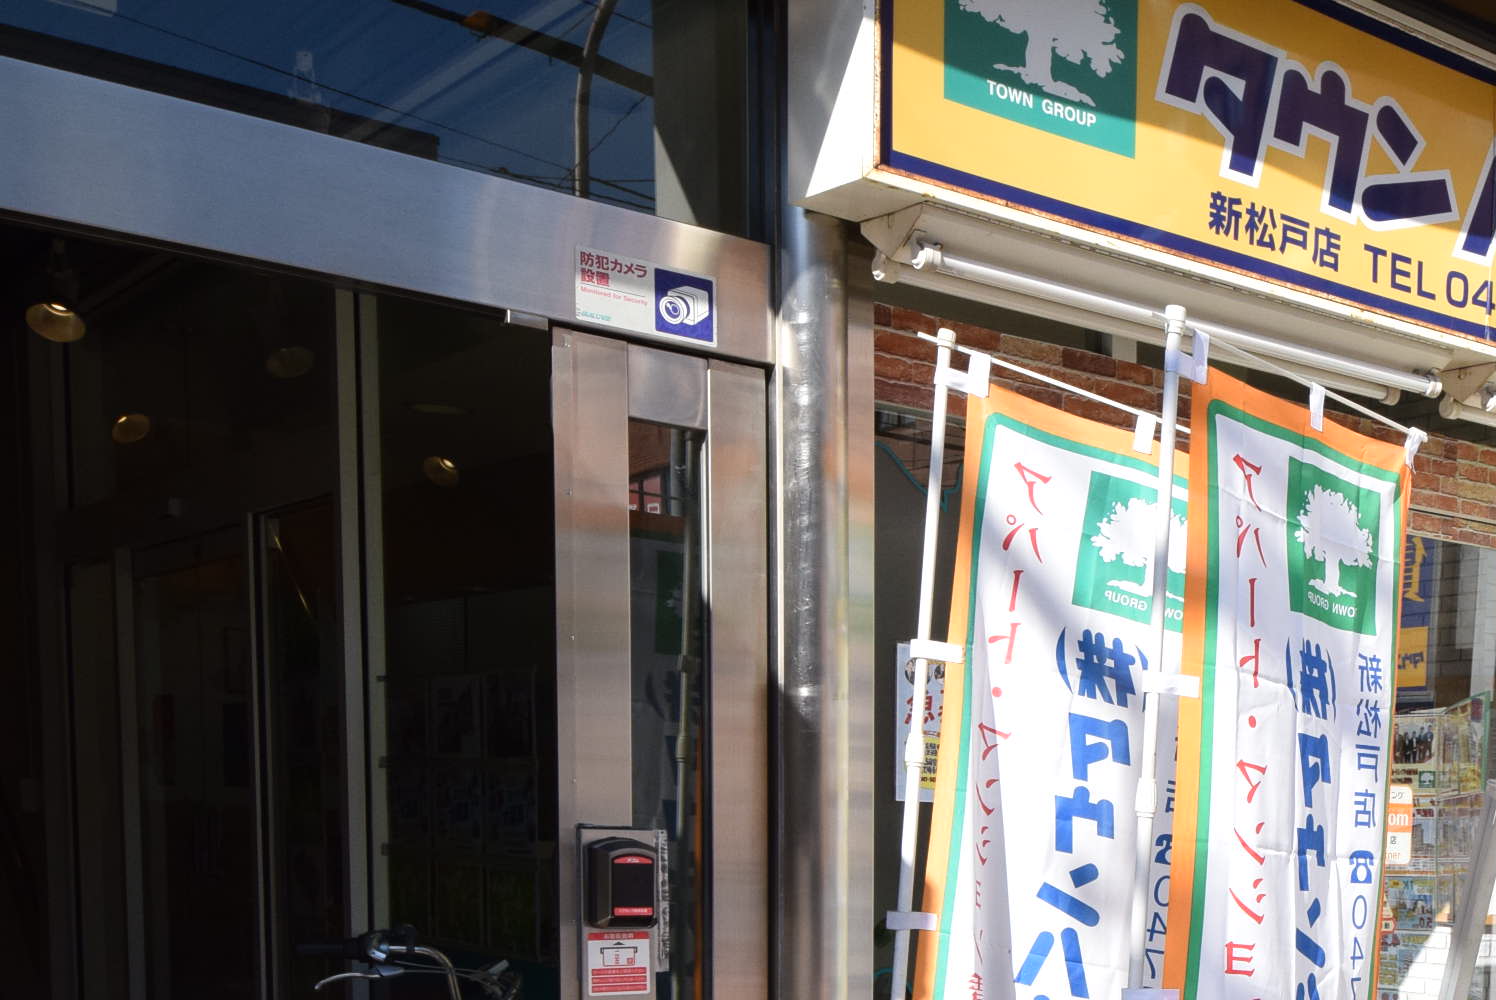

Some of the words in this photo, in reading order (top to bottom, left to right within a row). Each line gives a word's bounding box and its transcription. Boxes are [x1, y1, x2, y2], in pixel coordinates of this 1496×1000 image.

[986, 79, 1034, 108] TOWN
[1040, 98, 1098, 130] GROUP
[580, 251, 648, 278] 防犯カメラ
[1209, 191, 1342, 272] 新松戸店
[1365, 247, 1436, 302] TEL
[580, 267, 610, 287] 設置
